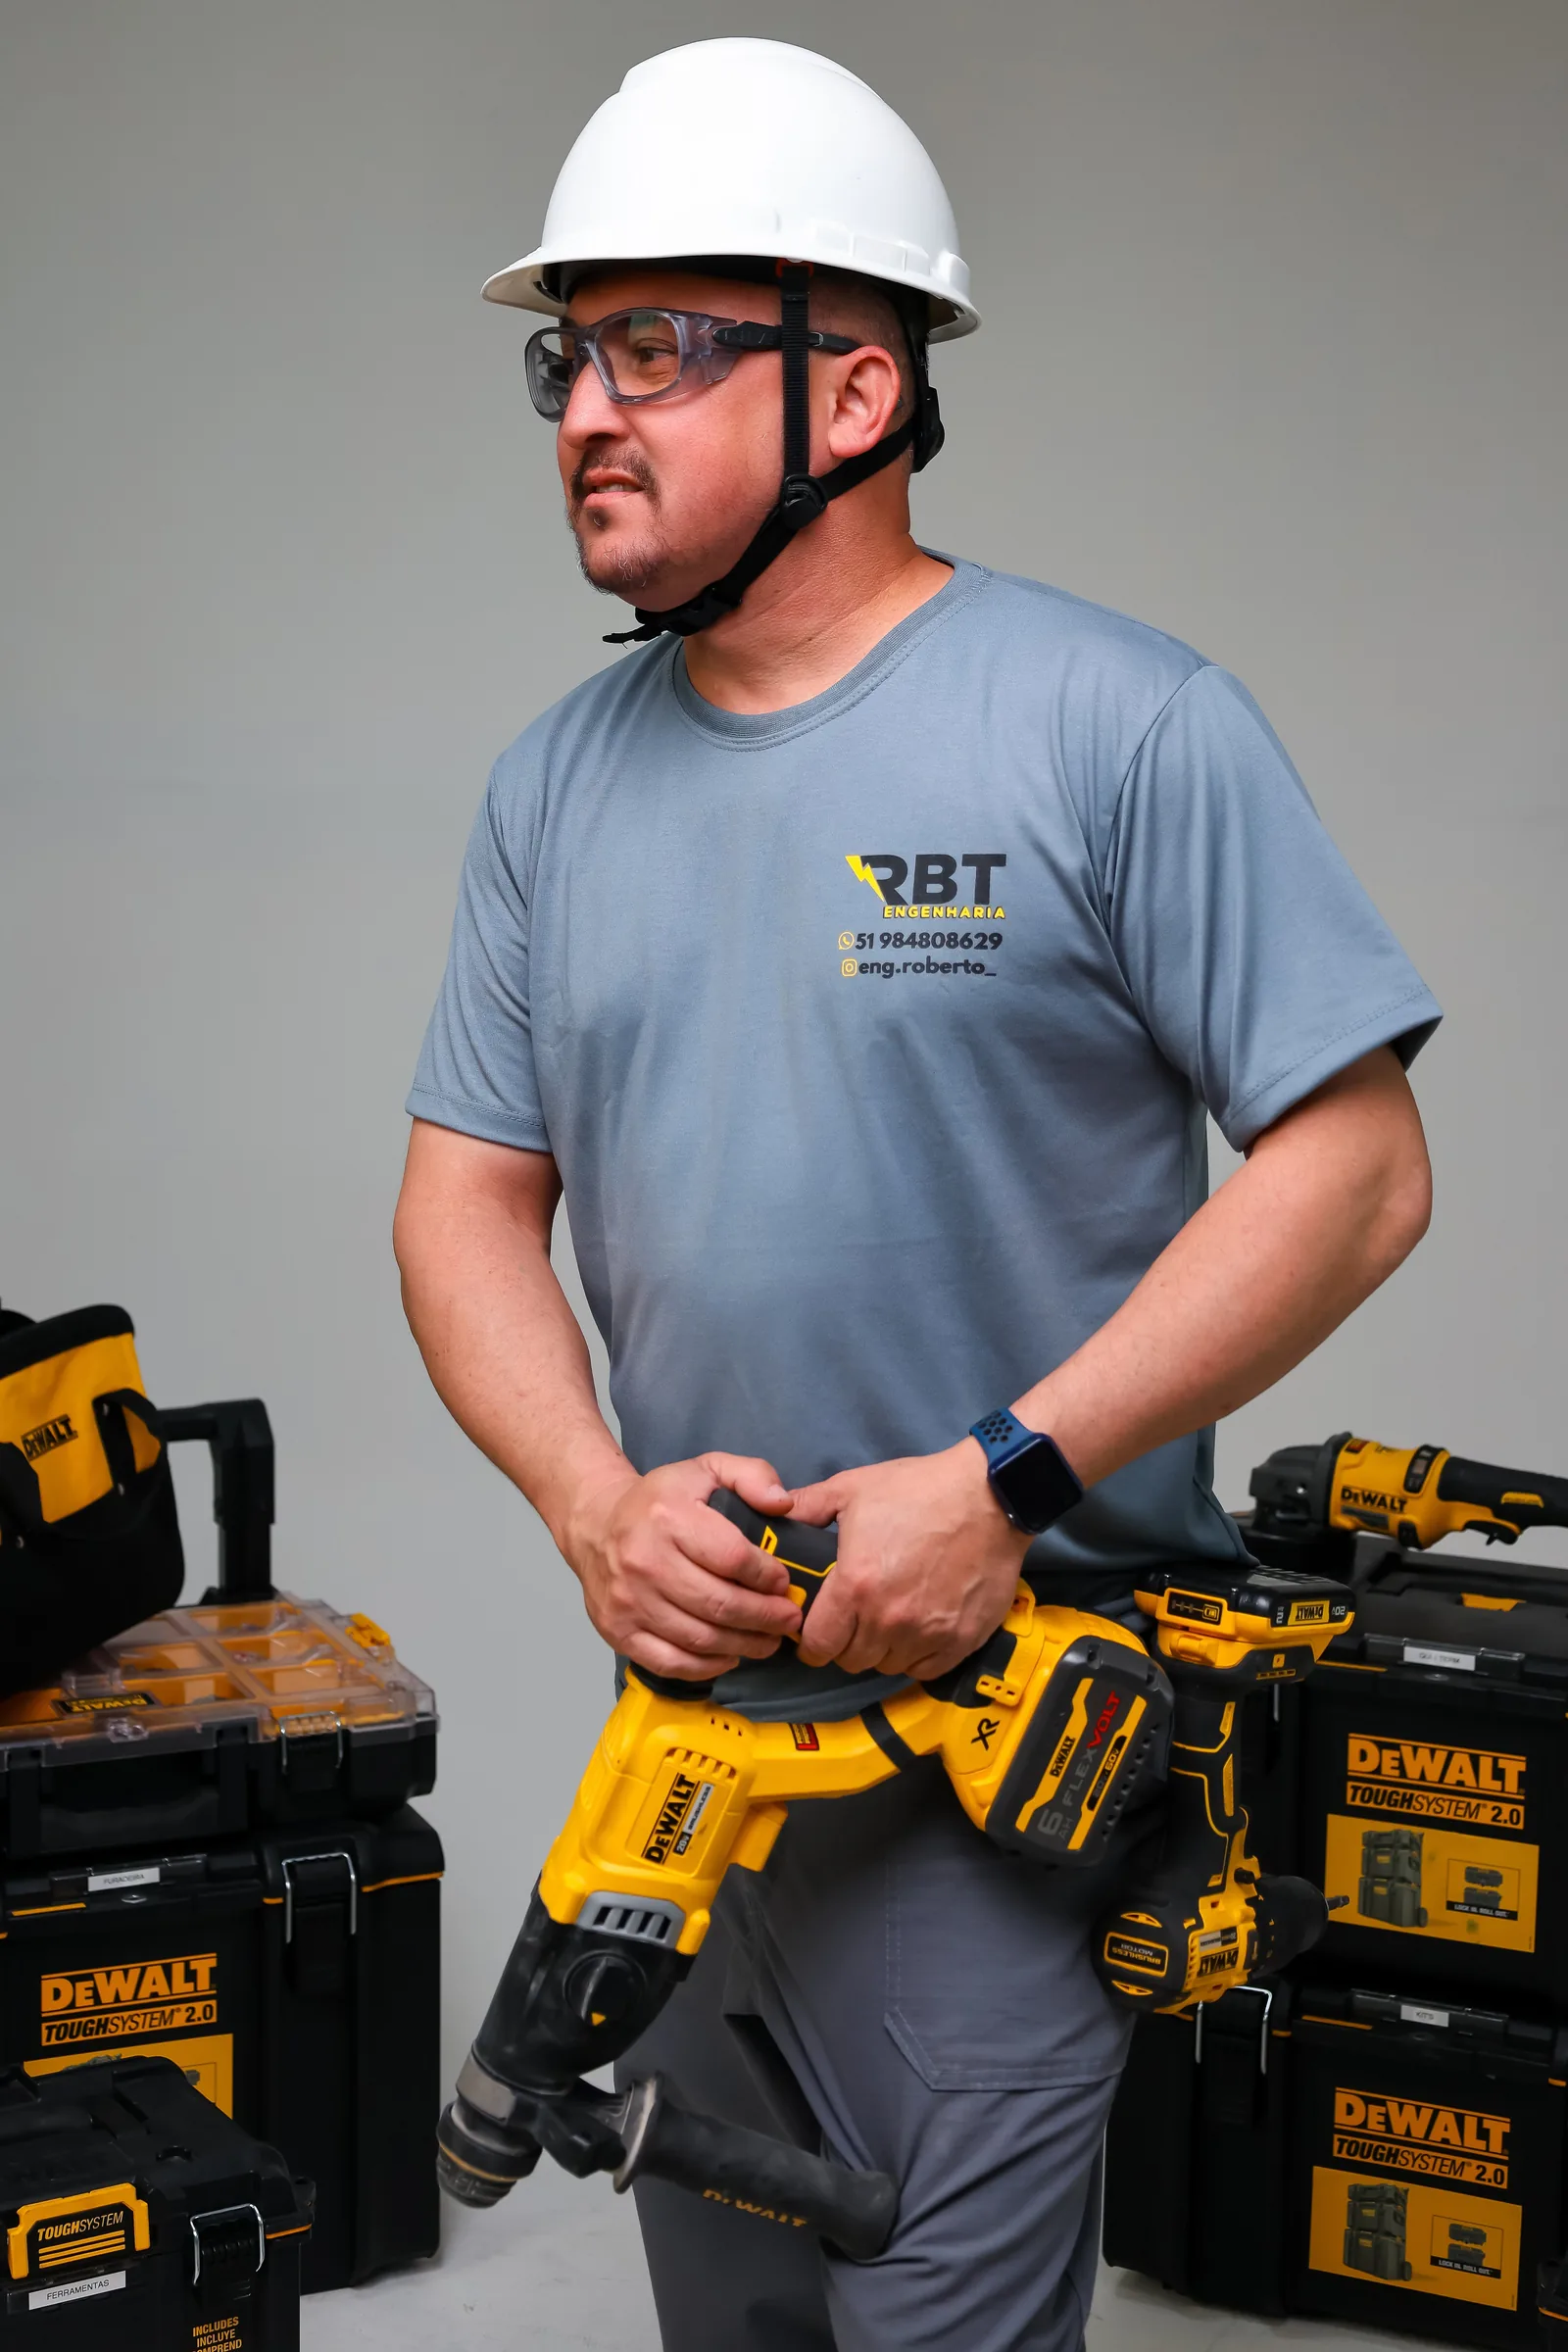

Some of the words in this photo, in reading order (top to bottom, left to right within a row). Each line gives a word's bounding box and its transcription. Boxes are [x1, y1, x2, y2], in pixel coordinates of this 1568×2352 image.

[845, 854, 1006, 906] RBT
[883, 906, 1005, 919] ENGENHARIA
[855, 933, 874, 950] 51
[879, 932, 1004, 951] 984808629
[858, 956, 997, 978] eng.roberto_
[970, 1718, 1001, 1751] XR
[1037, 1808, 1063, 1837] 6
[1491, 1805, 1521, 1826] 2.0
[184, 2003, 214, 2023] 2.0
[1475, 2164, 1505, 2185] 2.0
[37, 2210, 124, 2242] TOUGHSYSTEM
[46, 2279, 110, 2300] FERRAMENTAS
[192, 2316, 239, 2337] INCLUDES
[197, 2328, 235, 2348] INCLUYE
